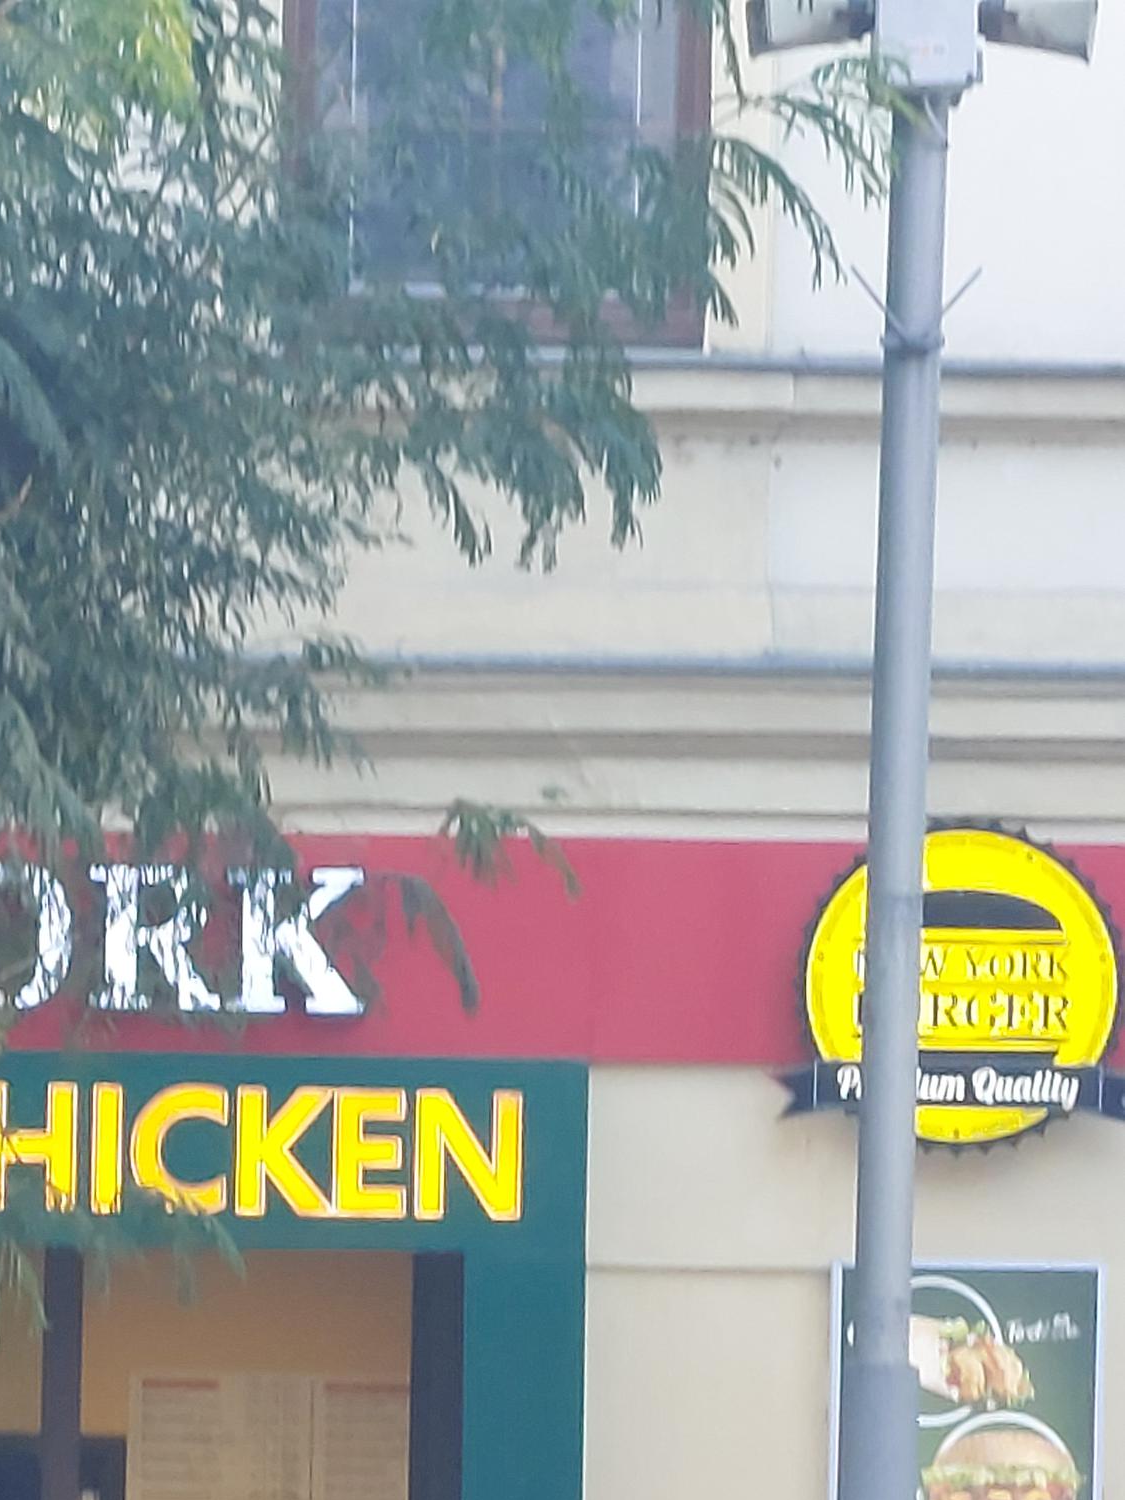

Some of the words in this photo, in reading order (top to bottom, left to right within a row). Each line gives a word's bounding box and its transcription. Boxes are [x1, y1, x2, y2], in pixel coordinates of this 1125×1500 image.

[965, 949, 1067, 980] YORK
[851, 993, 1069, 1031] RGER
[972, 1066, 1079, 1112] Quality
